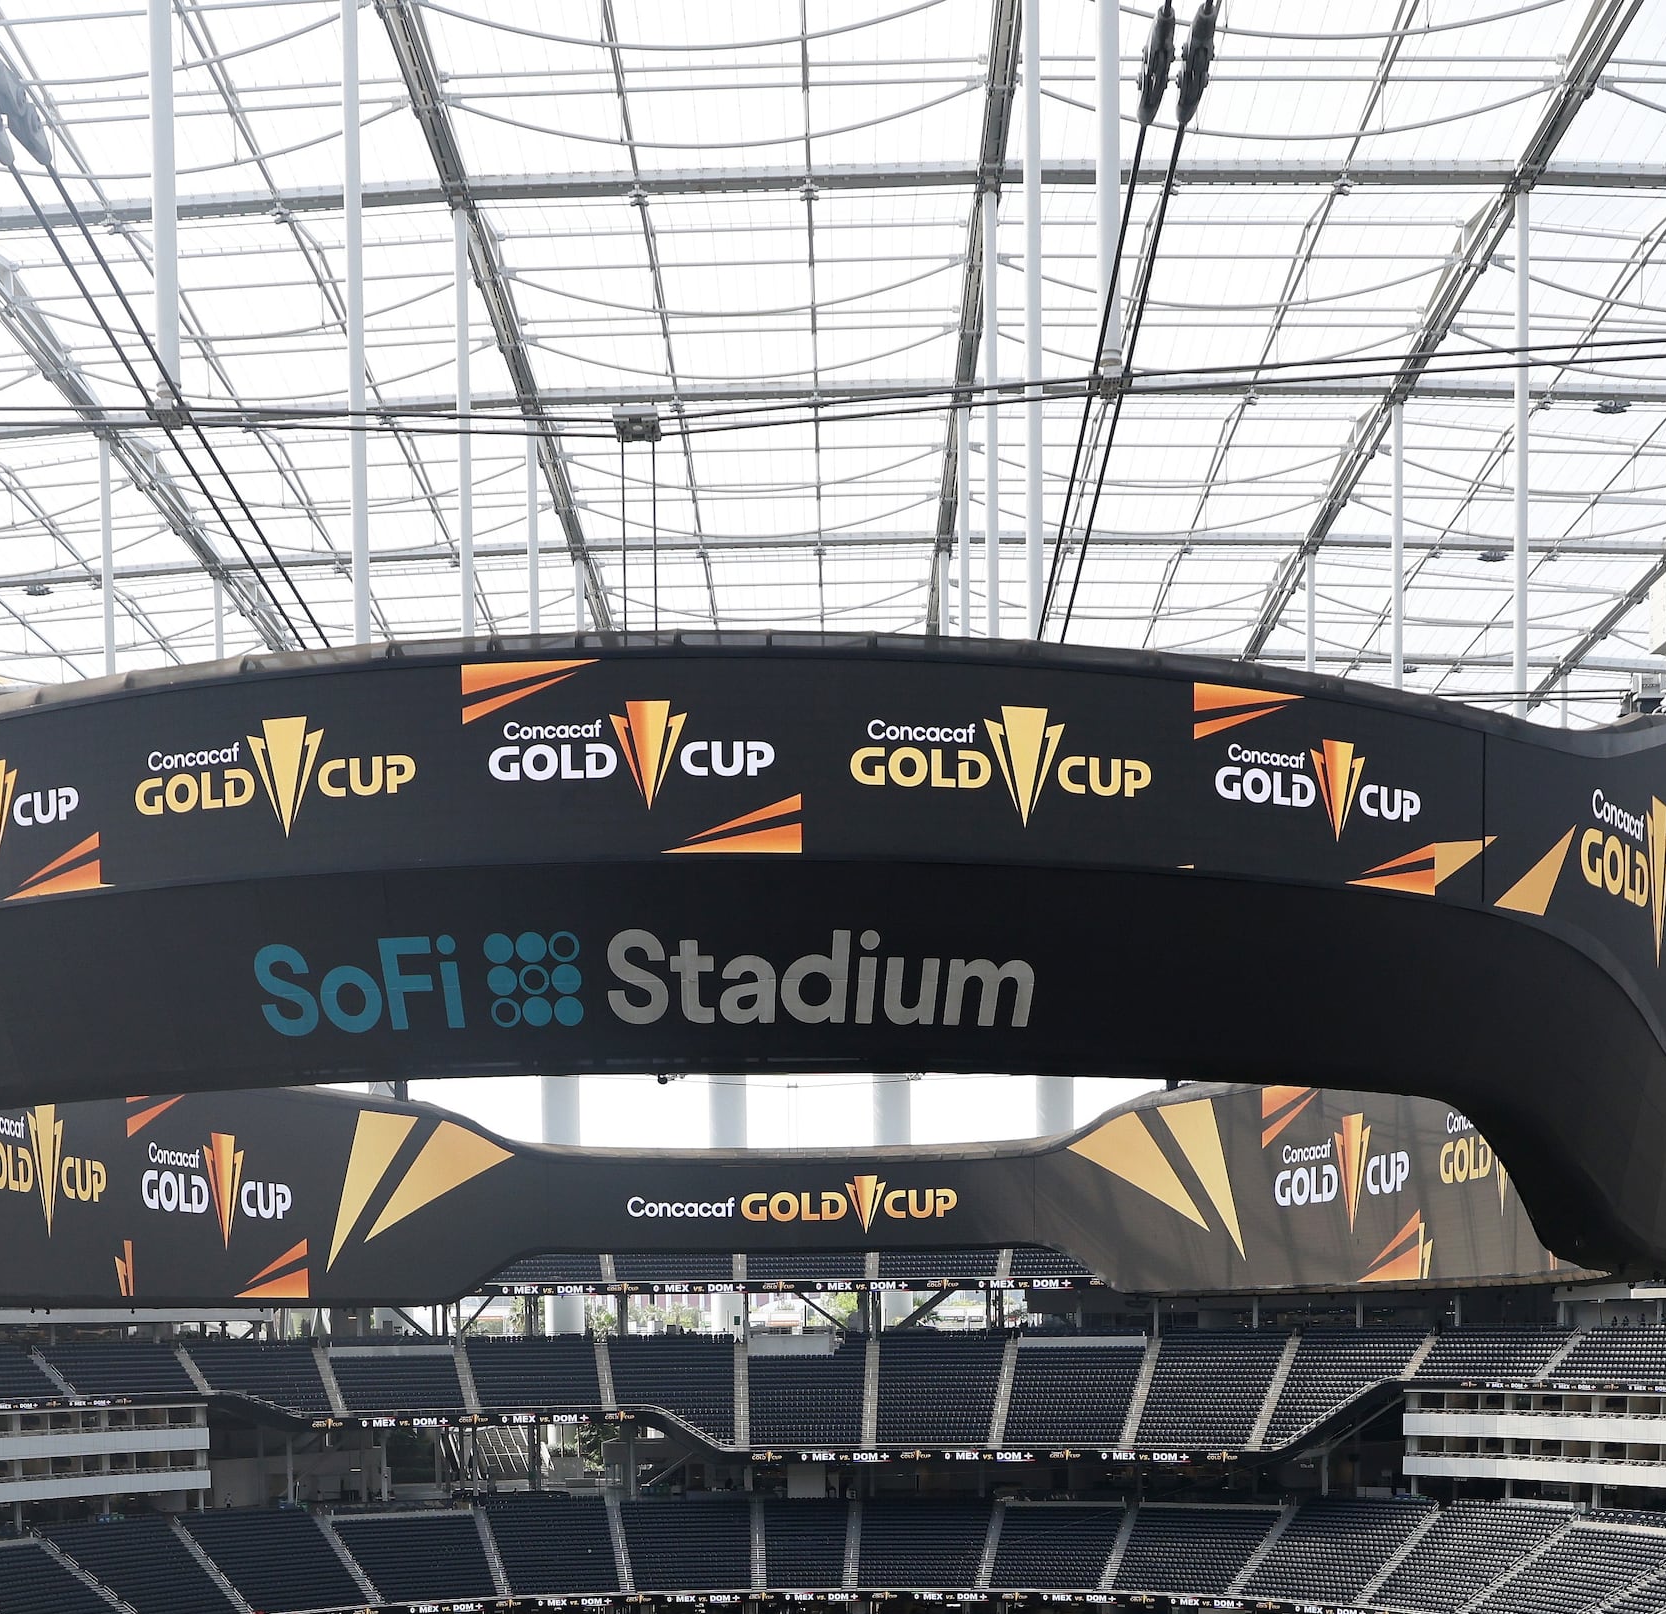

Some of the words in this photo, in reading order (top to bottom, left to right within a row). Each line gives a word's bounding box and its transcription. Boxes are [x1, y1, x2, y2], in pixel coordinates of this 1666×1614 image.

[501, 719, 601, 745] Concacaf
[866, 718, 976, 744] Concacaf
[146, 738, 240, 772] Concacaf
[487, 743, 618, 783] GOLD
[681, 739, 775, 778] CUP
[850, 745, 991, 789] GOLD
[1057, 753, 1152, 799] CUP
[1227, 743, 1305, 771] Concacaf
[134, 764, 255, 815] GOLD
[317, 753, 417, 799] CUP
[1214, 765, 1317, 808] GOLD
[1359, 784, 1421, 823] CUP
[13, 786, 79, 826] CUP
[1592, 788, 1645, 842] Concacaf
[1580, 828, 1650, 907] GOLD
[254, 932, 467, 1038] SoFi
[607, 929, 1035, 1029] Stadium
[147, 1141, 200, 1168] Concacaf
[1282, 1138, 1332, 1164] Concacaf
[1439, 1134, 1492, 1185] GOLD
[61, 1155, 107, 1203] CUP
[141, 1169, 209, 1215] GOLD
[240, 1180, 293, 1220] CUP
[1274, 1164, 1339, 1207] GOLD
[1366, 1150, 1410, 1195] CUP
[626, 1195, 735, 1221] Concacaf
[741, 1191, 846, 1223] GOLD
[884, 1187, 958, 1220] CUP
[514, 1285, 539, 1295] MEX
[556, 1284, 583, 1294] DOM
[827, 1281, 852, 1291] MEX
[869, 1280, 896, 1290] DOM
[812, 1451, 836, 1461] MEX
[852, 1451, 878, 1461] DOM
